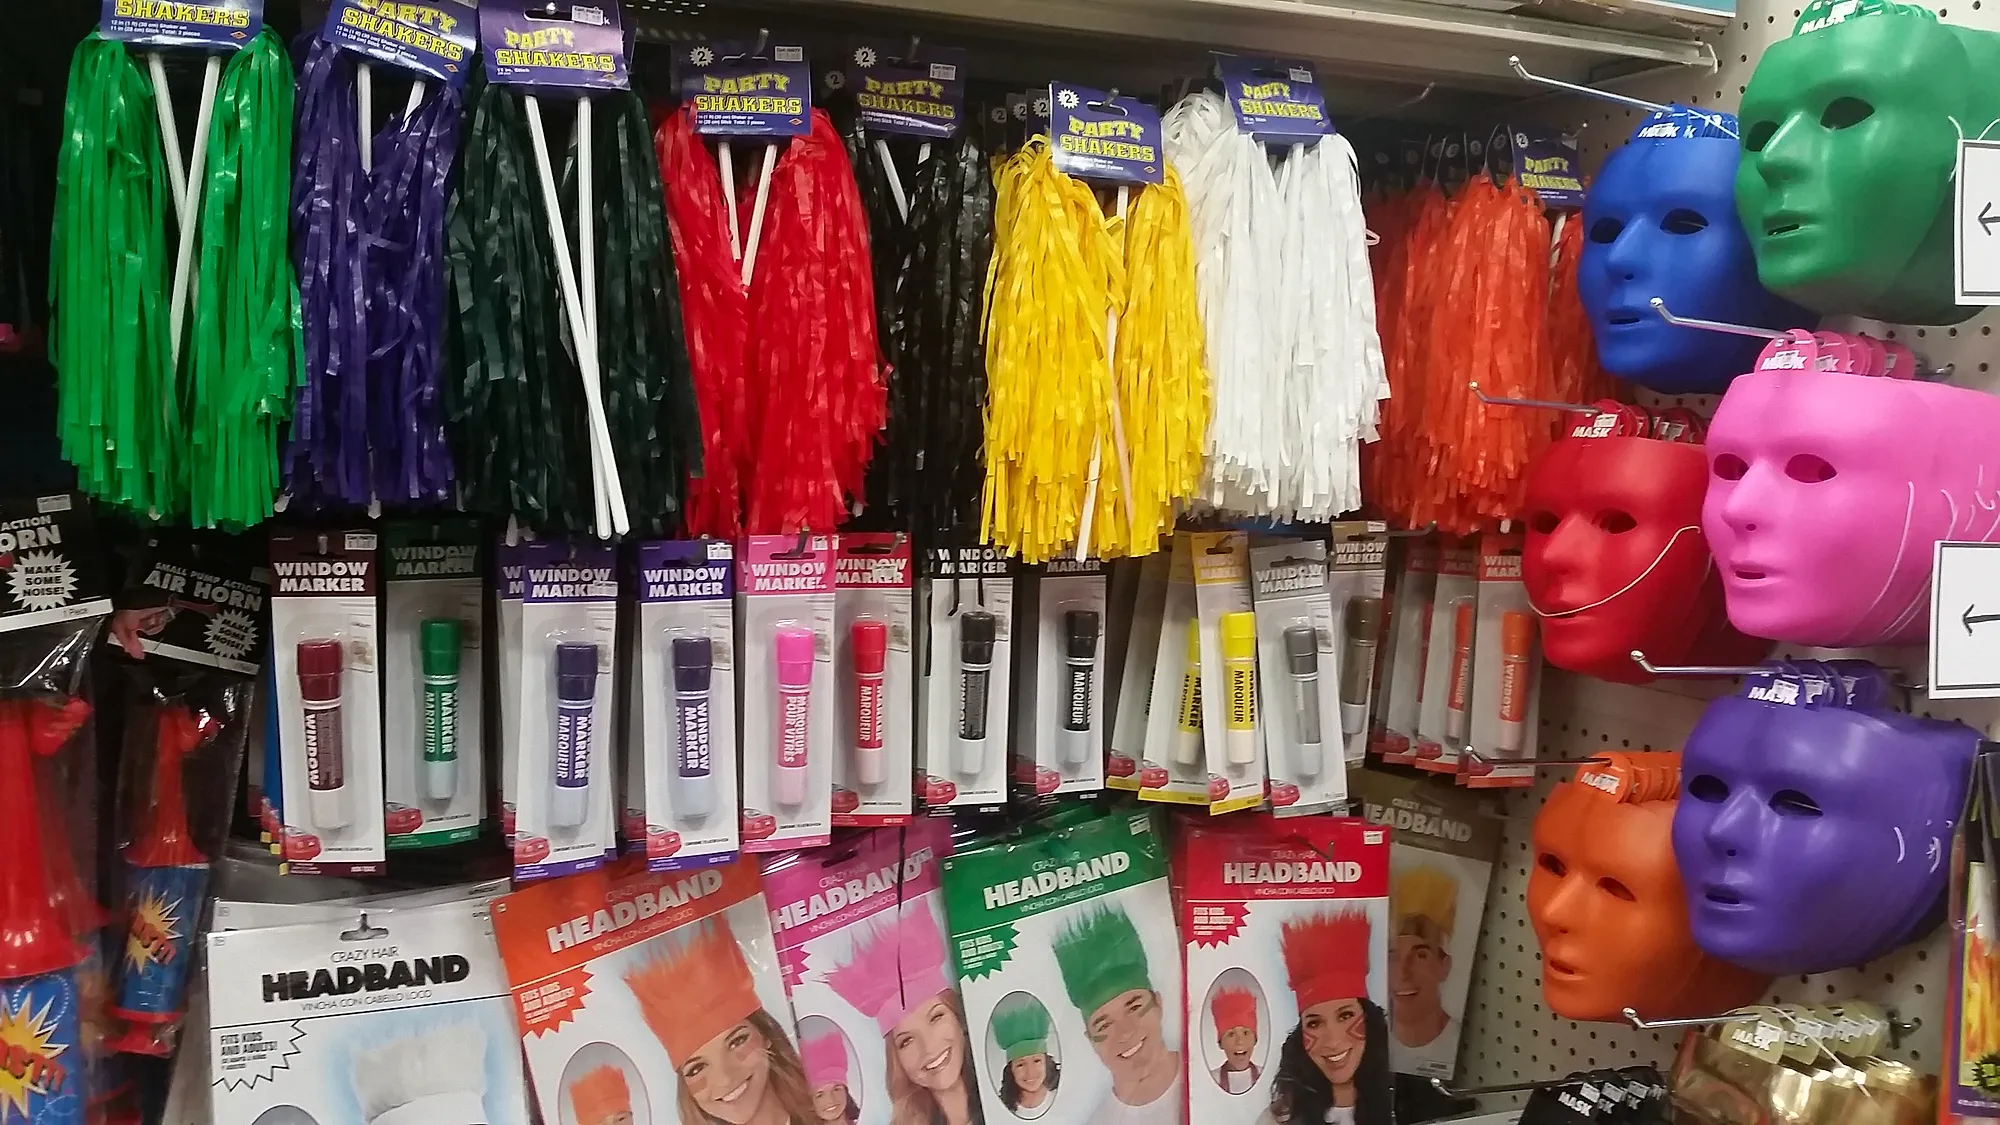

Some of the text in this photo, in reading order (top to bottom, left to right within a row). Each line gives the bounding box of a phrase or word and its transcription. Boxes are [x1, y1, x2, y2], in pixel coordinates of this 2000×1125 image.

[115, 0, 250, 28] SHAKERS
[357, 0, 457, 34] PARTY
[340, 6, 464, 62] SHAKERS
[504, 27, 575, 49] PARTY
[495, 49, 616, 73] SHAKERS
[696, 51, 706, 62] 2
[861, 51, 870, 63] 2
[703, 73, 791, 95] PARTY
[865, 75, 944, 99] PARTY
[1240, 82, 1291, 100] PARTY
[693, 94, 803, 115] SHAKERS
[857, 93, 956, 119] SHAKERS
[1039, 101, 1047, 113] 2
[1064, 93, 1073, 104] 2
[1238, 97, 1323, 121] SHAKERS
[1068, 115, 1144, 142] PARTY
[1060, 133, 1155, 163] SHAKERS
[1524, 155, 1569, 173] PARTY
[1571, 426, 1612, 438] MASK
[0, 514, 52, 532] ACTION
[391, 546, 477, 560] WINDOW
[938, 548, 1008, 561] WNDOW
[1335, 541, 1387, 554] WINDOW
[274, 562, 369, 577] WINDOW
[836, 558, 907, 574] WINDOW
[1047, 560, 1101, 572] MARKER
[1335, 553, 1383, 565] MARKER
[24, 565, 62, 576] MAKE
[25, 575, 62, 585] SOME
[155, 562, 262, 596] SMALL PUMP ACTION
[528, 568, 612, 583] WINDOW
[643, 567, 728, 583] WINDOW
[1255, 563, 1324, 582] WINDOW
[22, 586, 65, 597] NOISE!
[143, 570, 263, 612] AIR HORN
[279, 577, 365, 592] MARKER
[648, 581, 724, 598] MARKER
[218, 627, 248, 642] SOME
[221, 618, 250, 634] MAKE
[212, 635, 245, 651] NOISE!
[1072, 671, 1086, 725] MARQUEUR
[1233, 670, 1245, 723] MARQUEUR
[1500, 664, 1515, 717] WINDOW
[425, 692, 435, 753] MARQUEUR
[441, 692, 453, 754] MARKER
[859, 685, 872, 741] MARQUEUR
[684, 706, 699, 769] MARKER
[697, 701, 709, 770] WINDOW
[783, 696, 797, 763] POUR VITRES
[306, 713, 320, 786] WINDOW
[557, 714, 570, 779] MARQUEUR
[574, 716, 588, 779] MARKER
[983, 851, 1130, 910] HEADBAND
[1223, 861, 1362, 884] HEADBAND
[771, 857, 922, 934] HEADBAND
[546, 869, 723, 954] HEADBAND
[330, 945, 400, 964] CRAZY HAIR
[261, 953, 471, 1003] HEADBAND
[301, 1000, 337, 1012] VINCHA
[340, 997, 363, 1008] CON
[365, 992, 402, 1005] CABELLO
[1732, 1029, 1771, 1051] MASK
[1558, 1091, 1593, 1117] MASK
